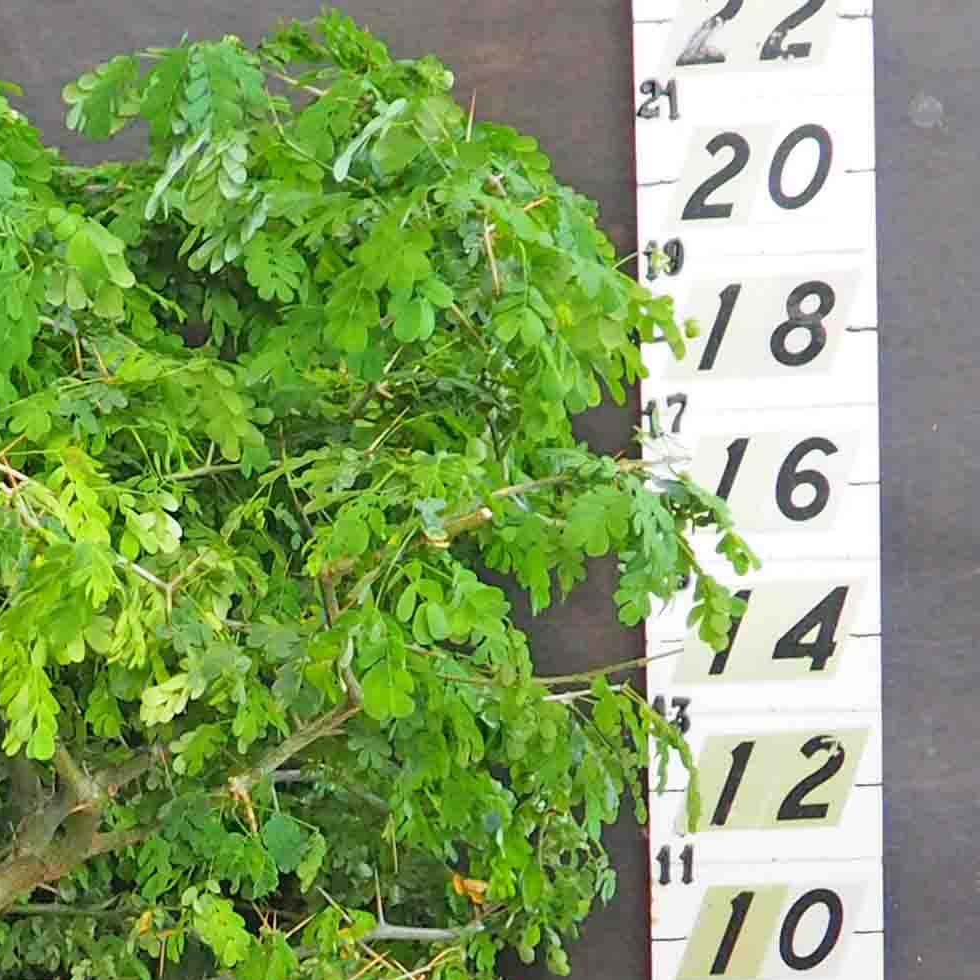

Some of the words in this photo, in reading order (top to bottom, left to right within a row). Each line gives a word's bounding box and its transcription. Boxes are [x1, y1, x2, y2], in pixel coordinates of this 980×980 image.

[676, 0, 824, 66] 22
[636, 79, 680, 121] 21
[681, 123, 833, 220] 20
[642, 237, 684, 281] 19
[697, 280, 836, 371] 18
[642, 392, 687, 440] 17
[710, 437, 838, 522] 16
[708, 586, 849, 676] 14
[710, 735, 845, 826] 12
[656, 845, 694, 886] 11
[710, 888, 844, 976] 10
